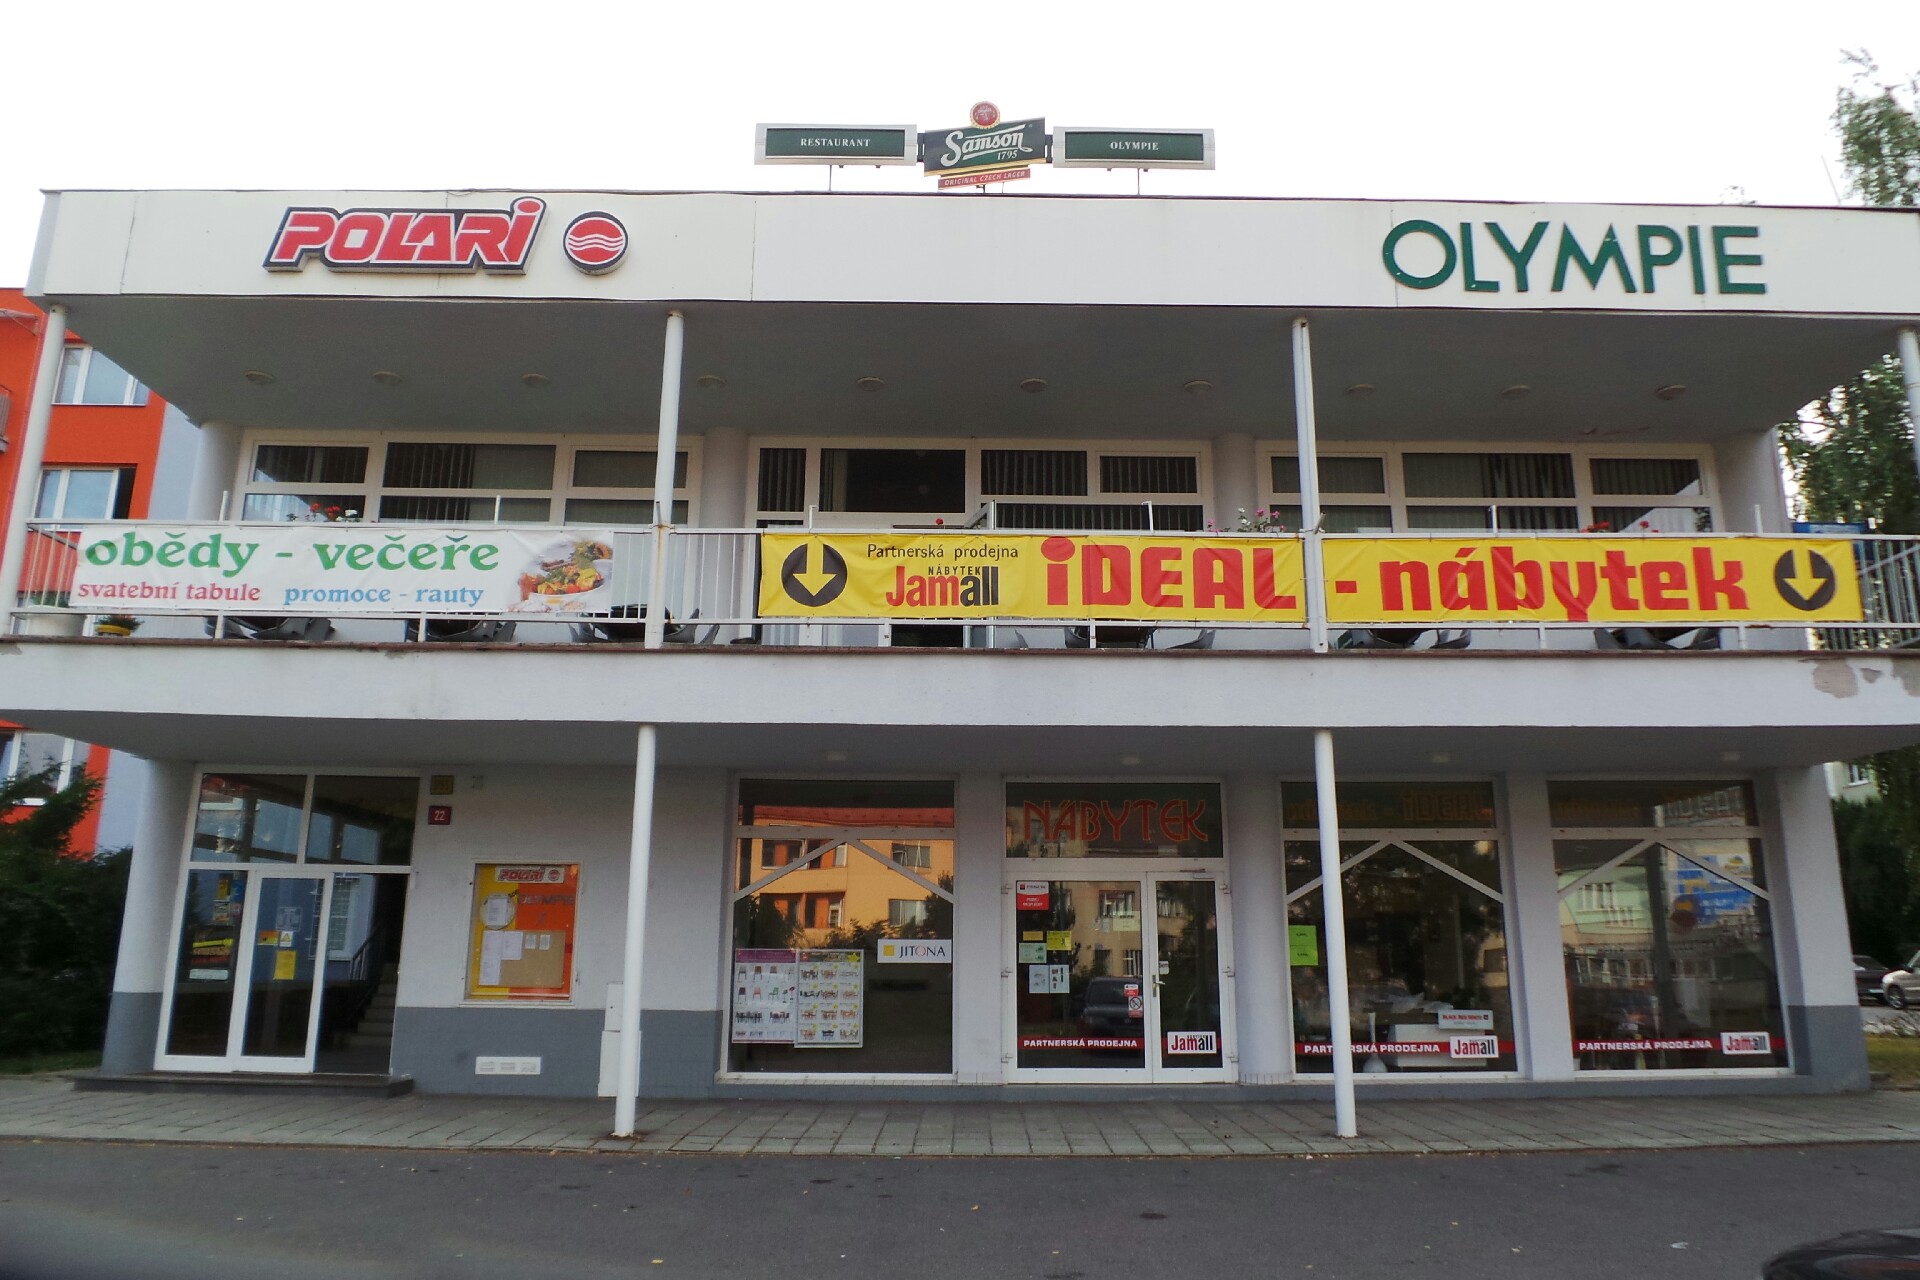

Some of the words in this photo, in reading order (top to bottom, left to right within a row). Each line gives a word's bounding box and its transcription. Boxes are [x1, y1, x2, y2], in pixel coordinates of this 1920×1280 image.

[800, 137, 871, 149] RESTAURANT
[941, 127, 1033, 167] Samson
[1109, 140, 1160, 152] OLYMPIE
[997, 150, 1018, 161] 1795
[944, 176, 978, 186] ORIGINAL
[979, 173, 1002, 182] CZECH
[1003, 170, 1026, 179] LAGER
[1382, 219, 1767, 295] OLYMPIE
[85, 531, 260, 578] obědy
[313, 534, 500, 571] večeře
[867, 543, 945, 559] Partnerská
[954, 543, 1019, 562] prodejna
[928, 563, 981, 576] NÁBYTEK
[885, 565, 999, 607] Jamall
[1379, 546, 1750, 622] nábytek
[77, 580, 180, 601] svatební
[185, 582, 261, 602] tabule
[284, 585, 392, 606] promoce
[416, 585, 485, 608] rauty
[434, 810, 446, 821] 22
[1023, 799, 1209, 842] NÁBYTEK
[899, 945, 946, 959] JITONA
[1023, 1037, 1086, 1047] PARTNERSKÁ
[1088, 1039, 1138, 1048] PRODEJNA
[1170, 1034, 1214, 1051] Jamall
[1304, 1043, 1378, 1053] PARTRSKÁ
[1380, 1044, 1441, 1053] PRODEJNA
[1454, 1039, 1495, 1055] Jamall
[1579, 1039, 1653, 1051] PARTNERSKÁ
[1654, 1039, 1713, 1050] PRODEJNA
[1726, 1035, 1768, 1052] Jamall
